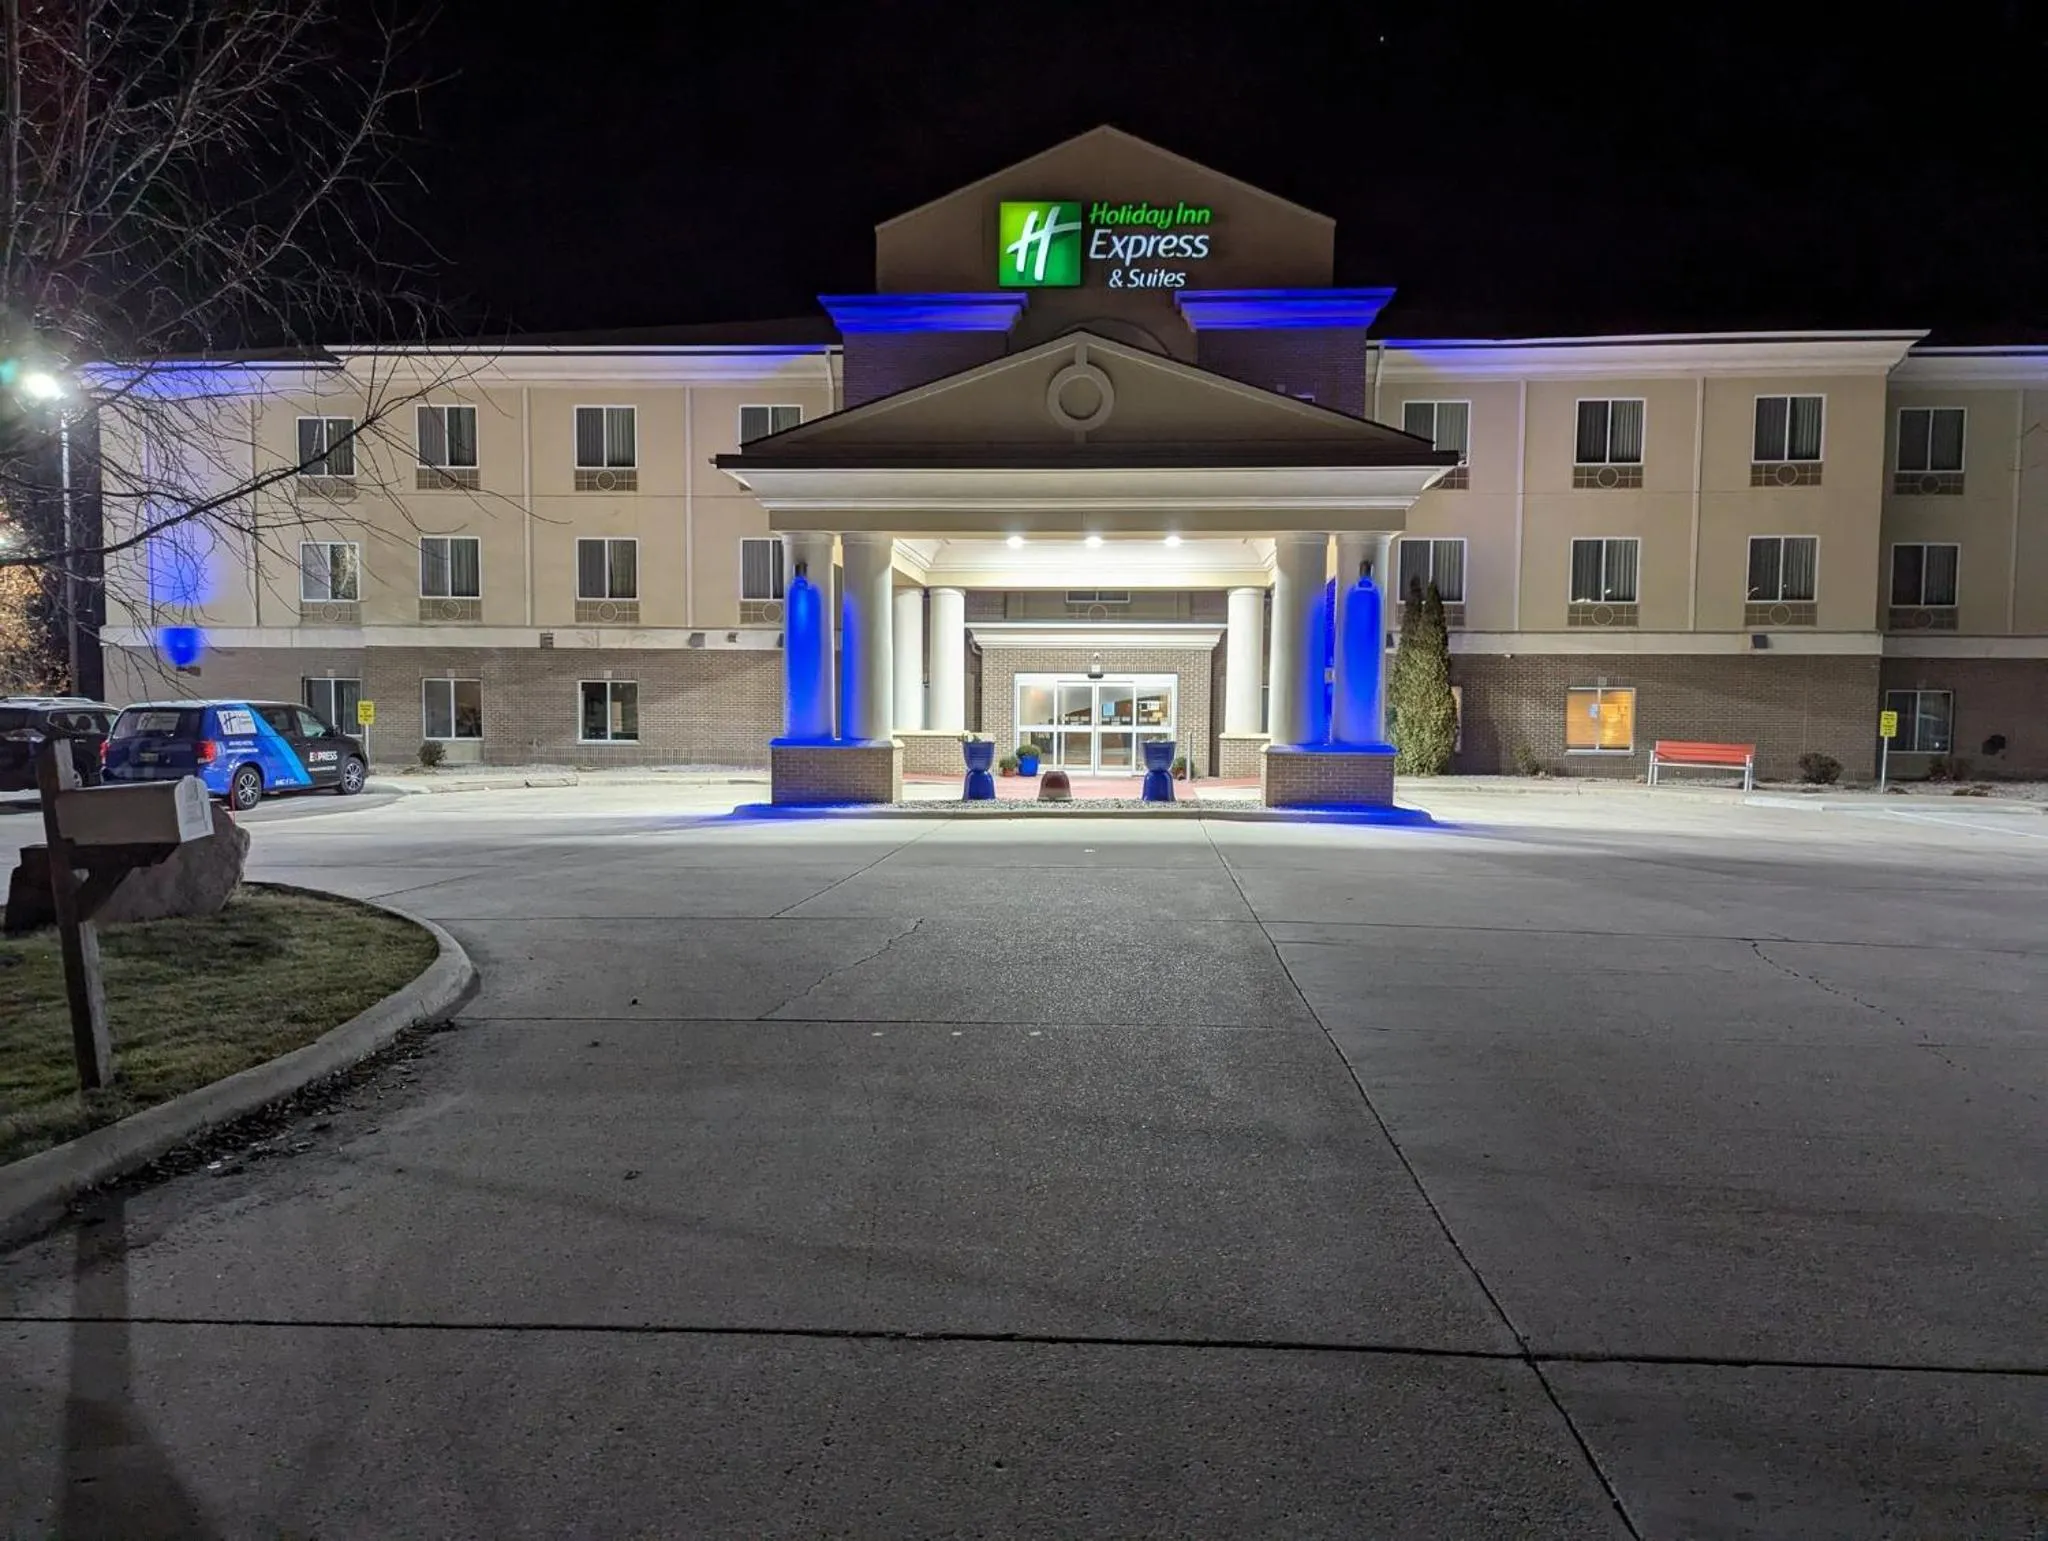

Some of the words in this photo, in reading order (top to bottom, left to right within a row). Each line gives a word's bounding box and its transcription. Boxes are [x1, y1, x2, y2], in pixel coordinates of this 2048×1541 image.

[1089, 202, 1173, 229] Holiday
[1176, 202, 1211, 224] Inn
[1089, 229, 1210, 266] Express
[1109, 269, 1123, 288] &
[1127, 268, 1186, 288] Suites
[309, 751, 338, 762] EXPRESS
